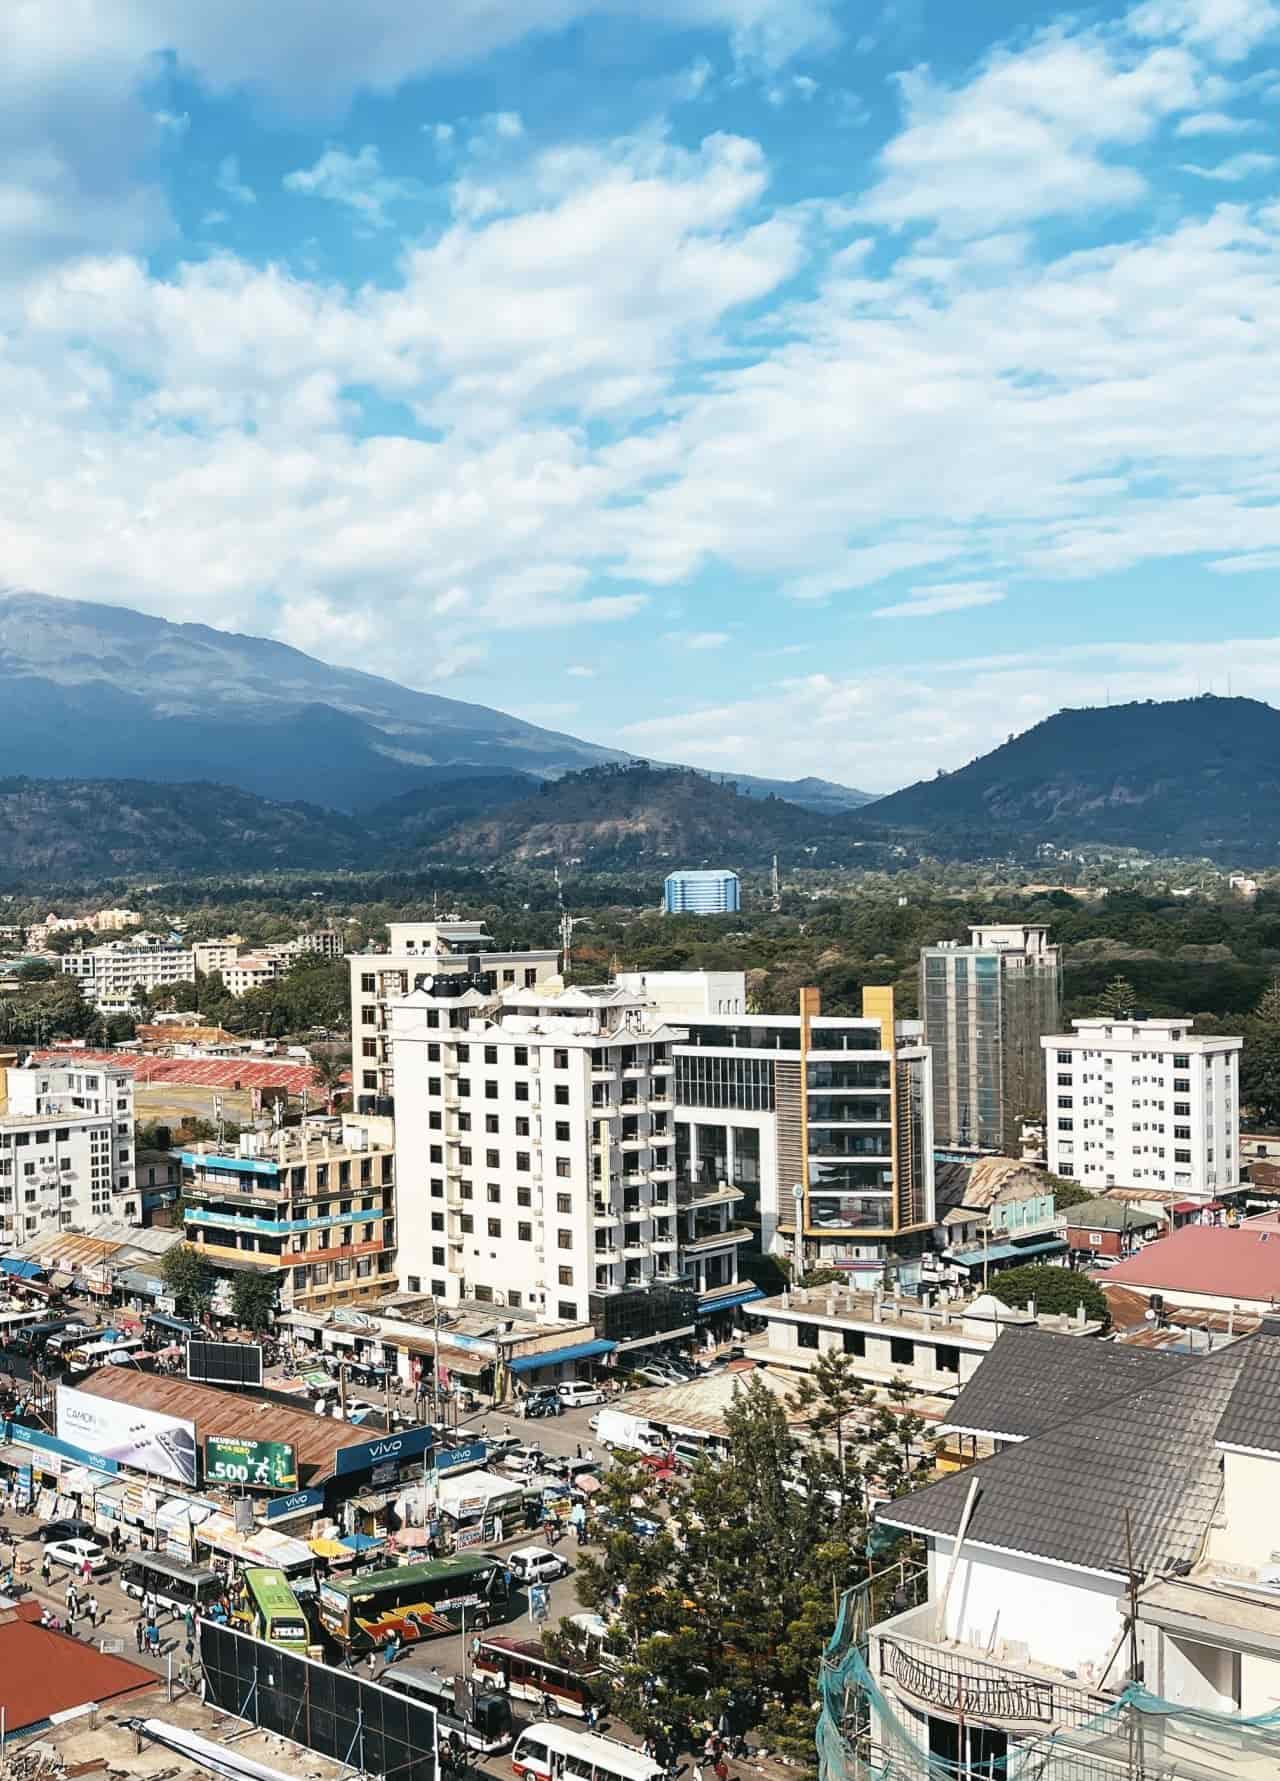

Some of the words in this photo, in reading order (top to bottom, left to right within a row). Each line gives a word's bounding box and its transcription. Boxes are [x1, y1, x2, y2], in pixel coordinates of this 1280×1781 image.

[369, 1440, 402, 1457] vivo
[88, 1455, 106, 1466] vivo
[450, 1449, 472, 1461] vivo
[215, 1462, 249, 1481] 500
[285, 1495, 308, 1507] vivo
